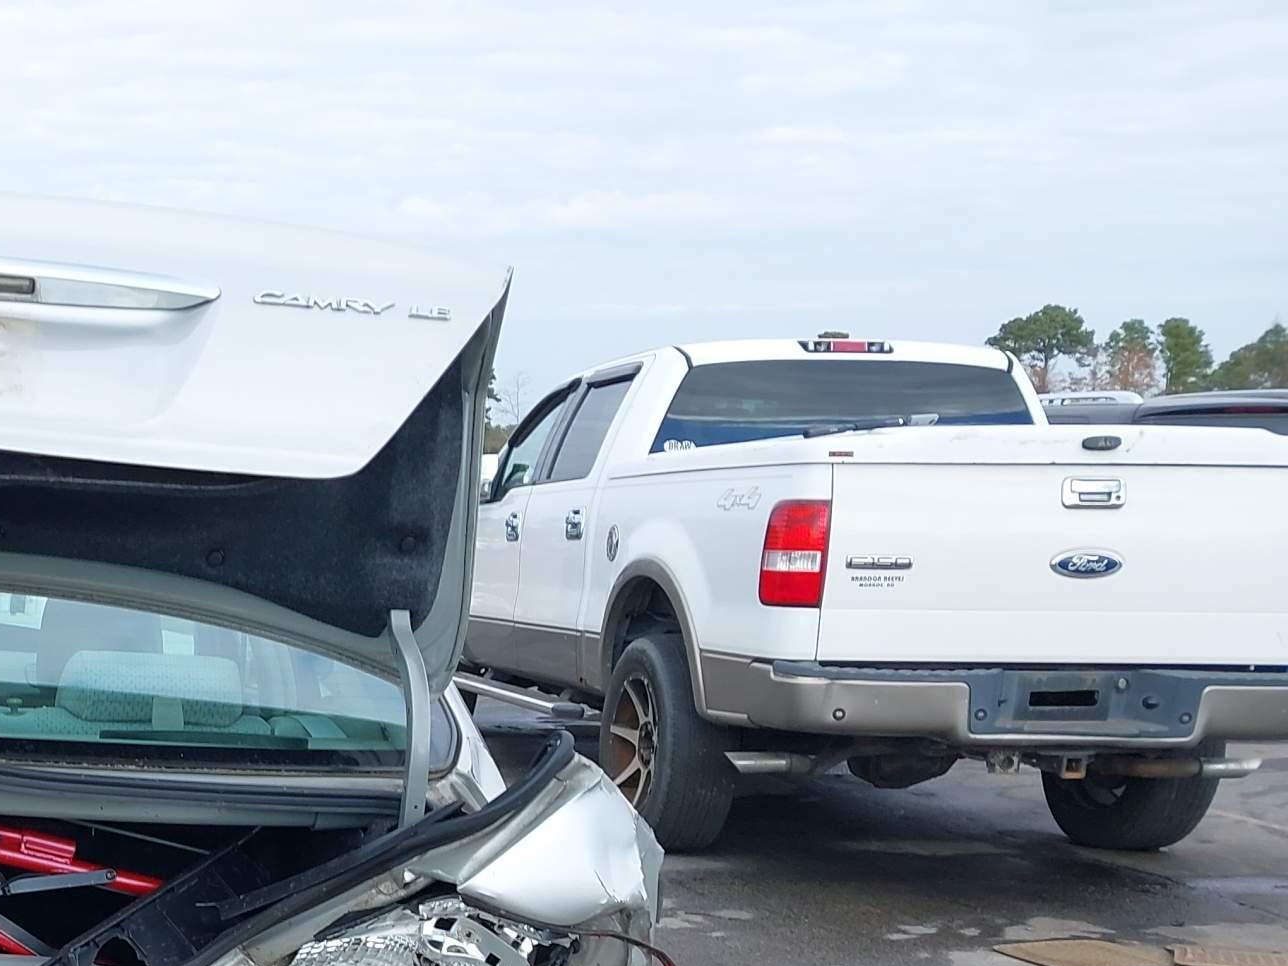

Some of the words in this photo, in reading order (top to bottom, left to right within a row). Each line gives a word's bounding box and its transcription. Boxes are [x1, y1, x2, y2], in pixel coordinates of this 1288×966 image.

[253, 290, 396, 316] CAMRY
[407, 303, 451, 321] LE
[1067, 554, 1109, 572] Ford
